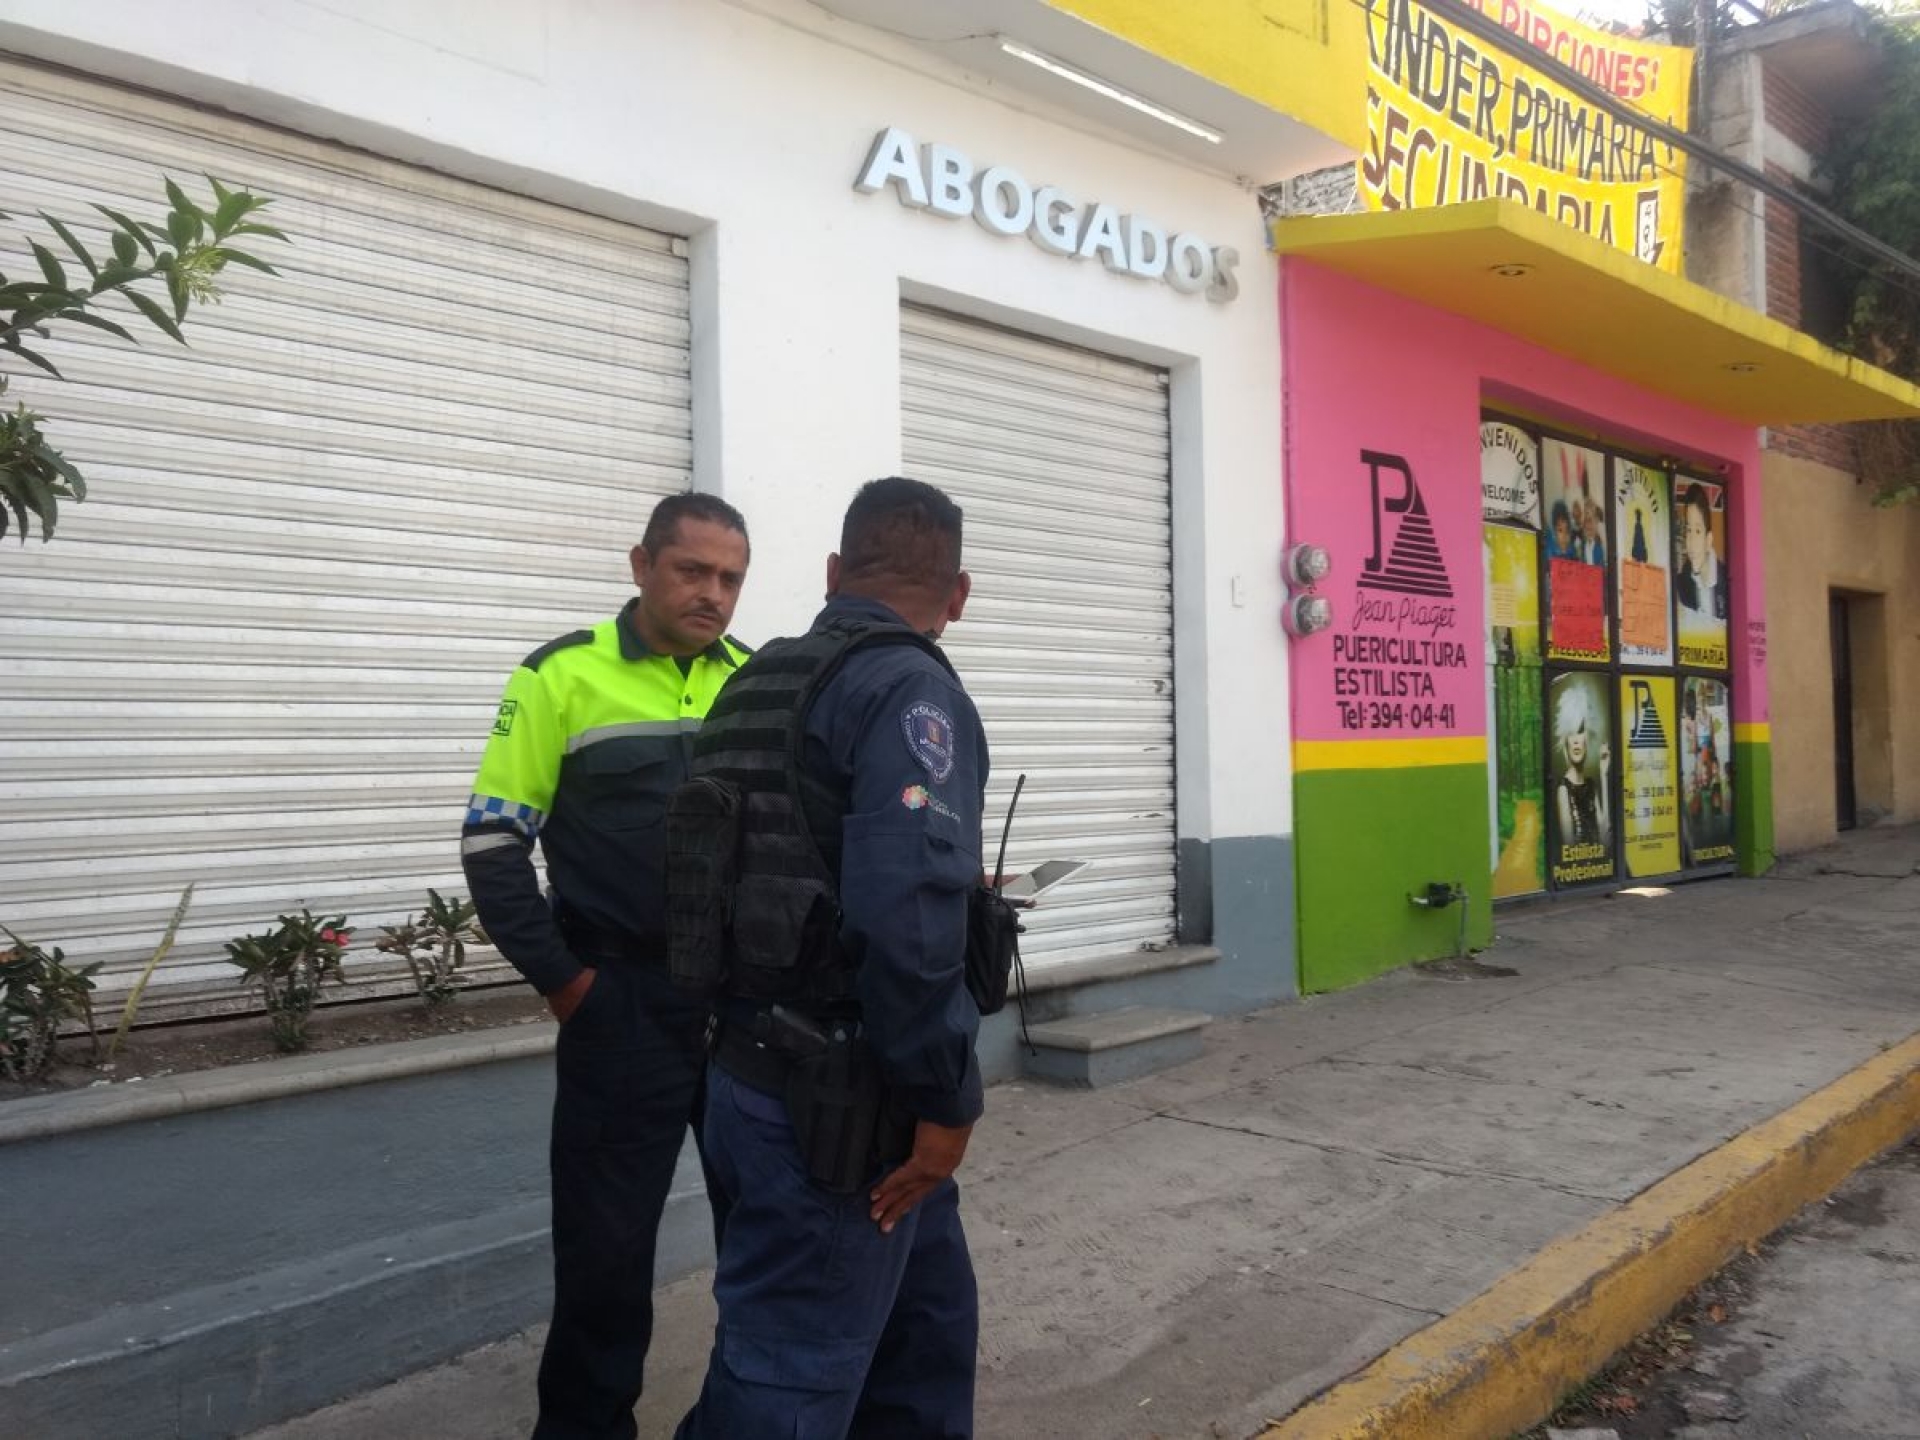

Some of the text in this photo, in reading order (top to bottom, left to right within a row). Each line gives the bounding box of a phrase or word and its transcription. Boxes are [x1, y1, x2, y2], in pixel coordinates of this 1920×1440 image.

[1508, 77, 1658, 182] PRIMARIA
[853, 126, 1240, 302] ABOGADOS
[1352, 590, 1396, 631] Jean
[1397, 597, 1457, 638] Piaget
[1333, 634, 1467, 668] PUERICULTURA
[1334, 667, 1436, 698] ESTILISTA
